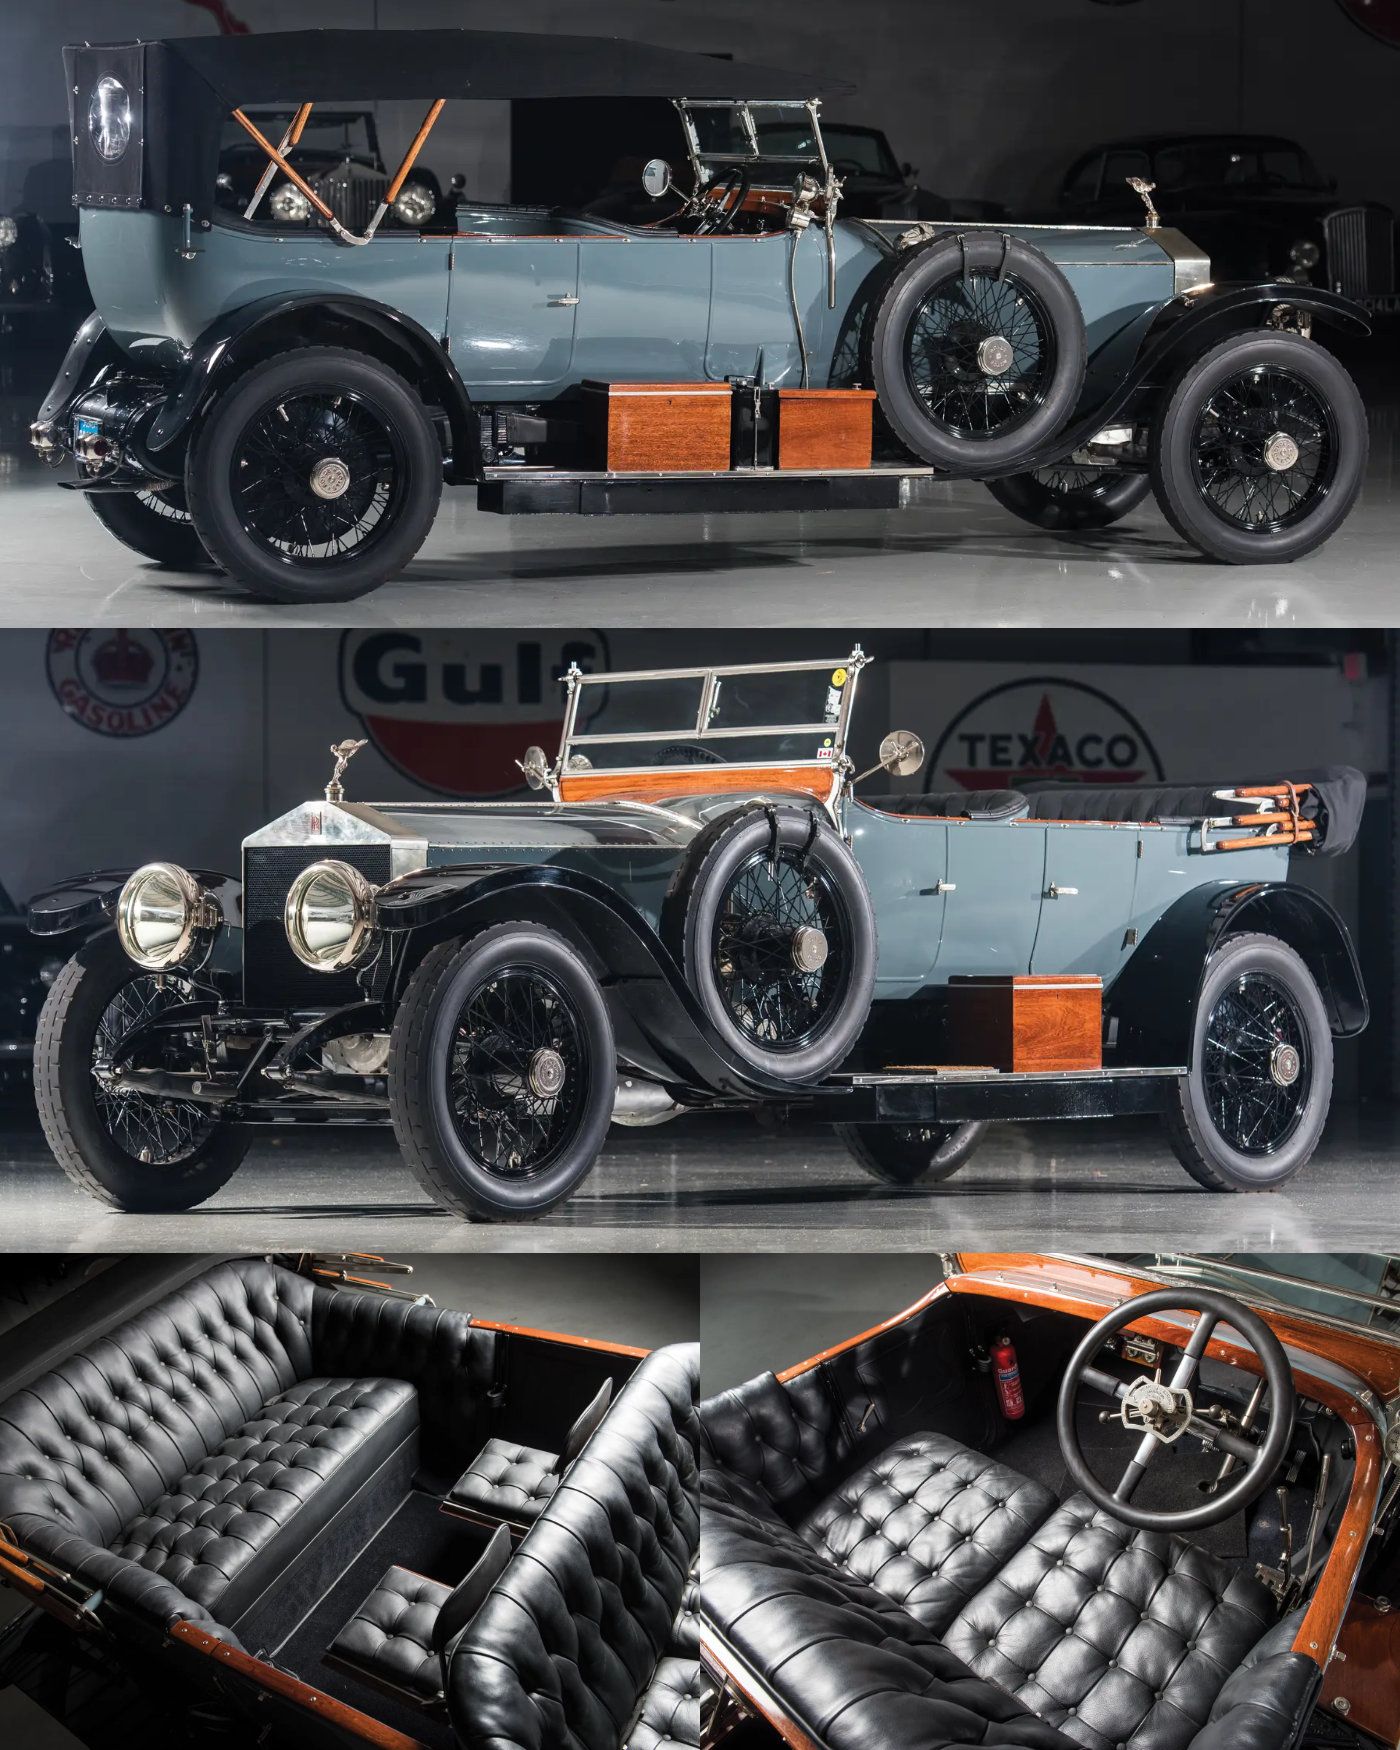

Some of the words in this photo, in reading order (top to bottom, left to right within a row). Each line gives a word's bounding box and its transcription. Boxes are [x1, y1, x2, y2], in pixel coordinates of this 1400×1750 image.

[353, 632, 597, 705] Gulf
[58, 678, 188, 731] GASOLINE
[958, 733, 1138, 768] TEXACO
